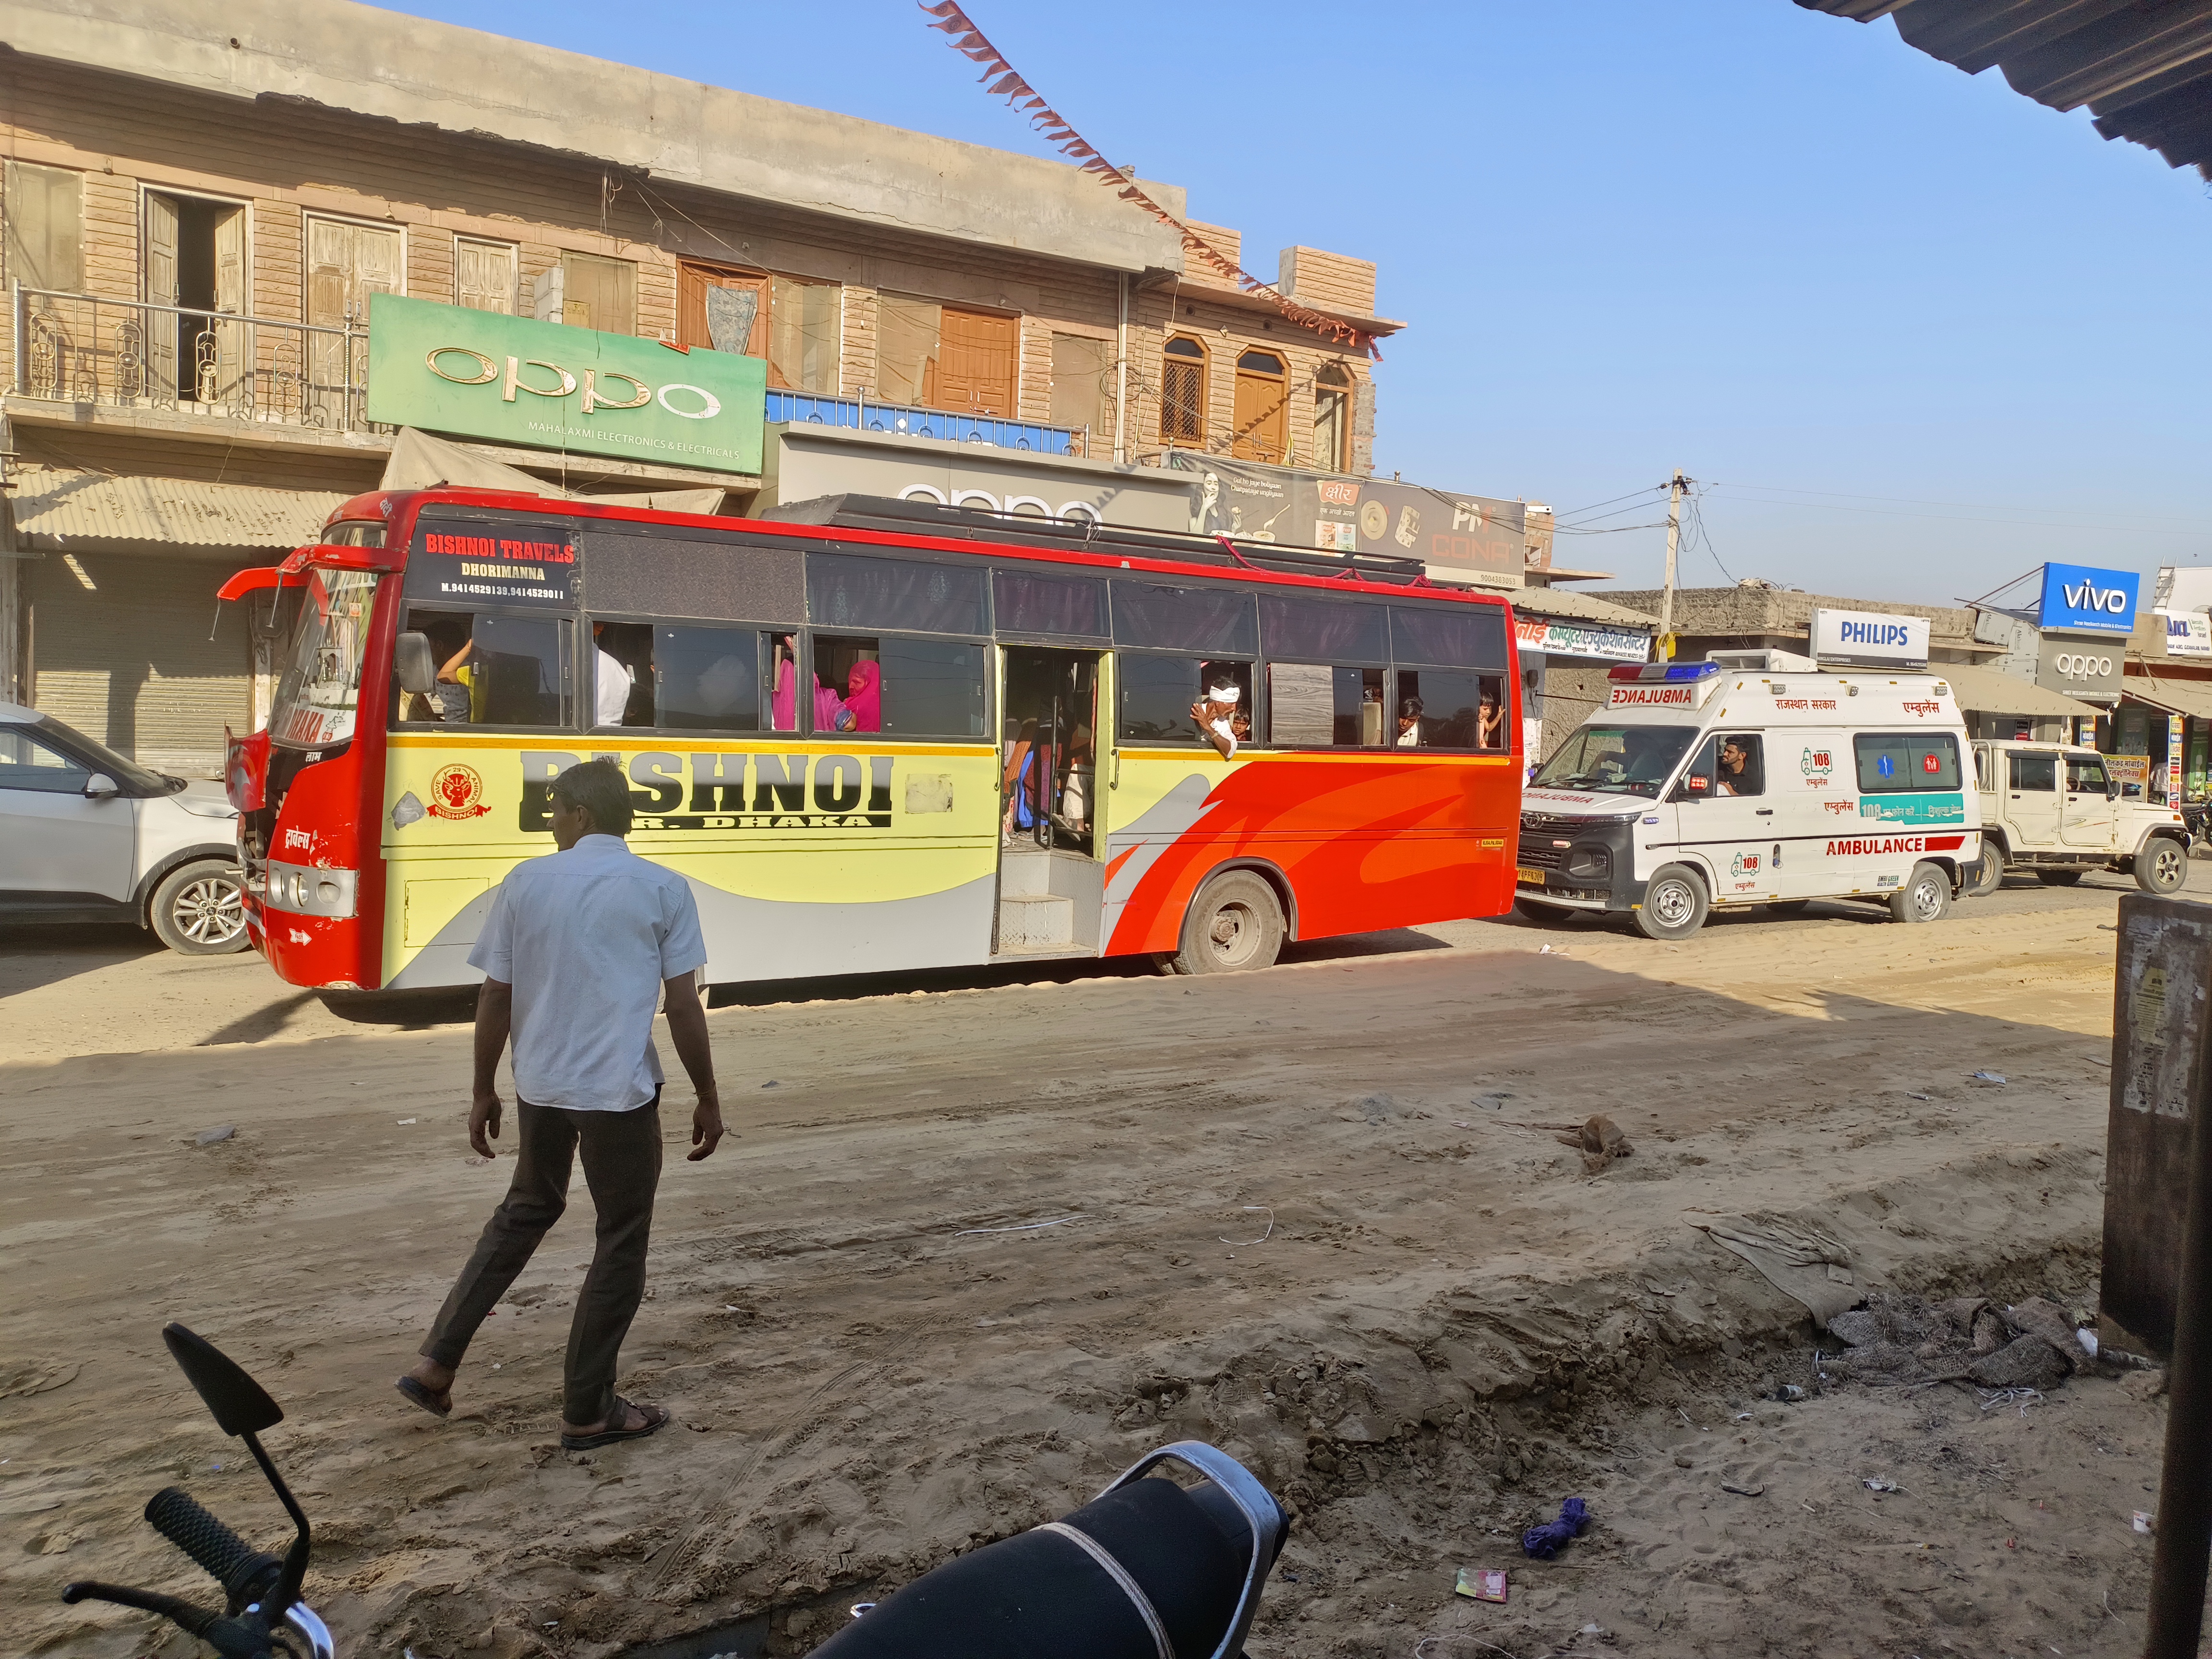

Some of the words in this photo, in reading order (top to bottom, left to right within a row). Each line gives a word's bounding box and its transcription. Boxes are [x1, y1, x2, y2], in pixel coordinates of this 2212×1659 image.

[528, 421, 595, 438] MAHALAXMI
[597, 431, 666, 449] ELECTRONICS
[668, 441, 675, 450] &
[677, 442, 740, 459] ELECTRICALS
[1231, 485, 1260, 495] Chatpataye
[1249, 479, 1260, 487] jaye
[1325, 483, 1352, 501] क्षीर
[425, 533, 496, 557] BISHNOI
[500, 540, 575, 564] TRAVELS
[1432, 534, 1510, 565] CONA
[461, 562, 545, 581] DHORIMANNA
[2062, 578, 2126, 614] vivo
[1841, 621, 1908, 646] PHILIPS
[2055, 653, 2112, 682] oppo
[1775, 699, 1809, 710] राजस्थान
[1810, 700, 1837, 710] सरकार
[1902, 699, 1940, 717] एम्बुलेंस
[1813, 753, 1829, 766] 108
[435, 779, 443, 800] SAVE
[466, 777, 479, 803] ANIMAL
[519, 750, 894, 812] BSHNOI
[1806, 777, 1828, 788] एम्बुलेंस
[435, 806, 478, 819] BISHNOI
[1824, 799, 1854, 815] एम्बुलेंस
[1862, 803, 1881, 819] 108
[1892, 805, 1904, 817] फोन
[1905, 805, 1915, 816] करें
[704, 815, 872, 829] DHAKA
[285, 825, 311, 850] ट्रावेल्स
[1826, 837, 1923, 856] AMBULANCE
[1743, 857, 1758, 869] 108
